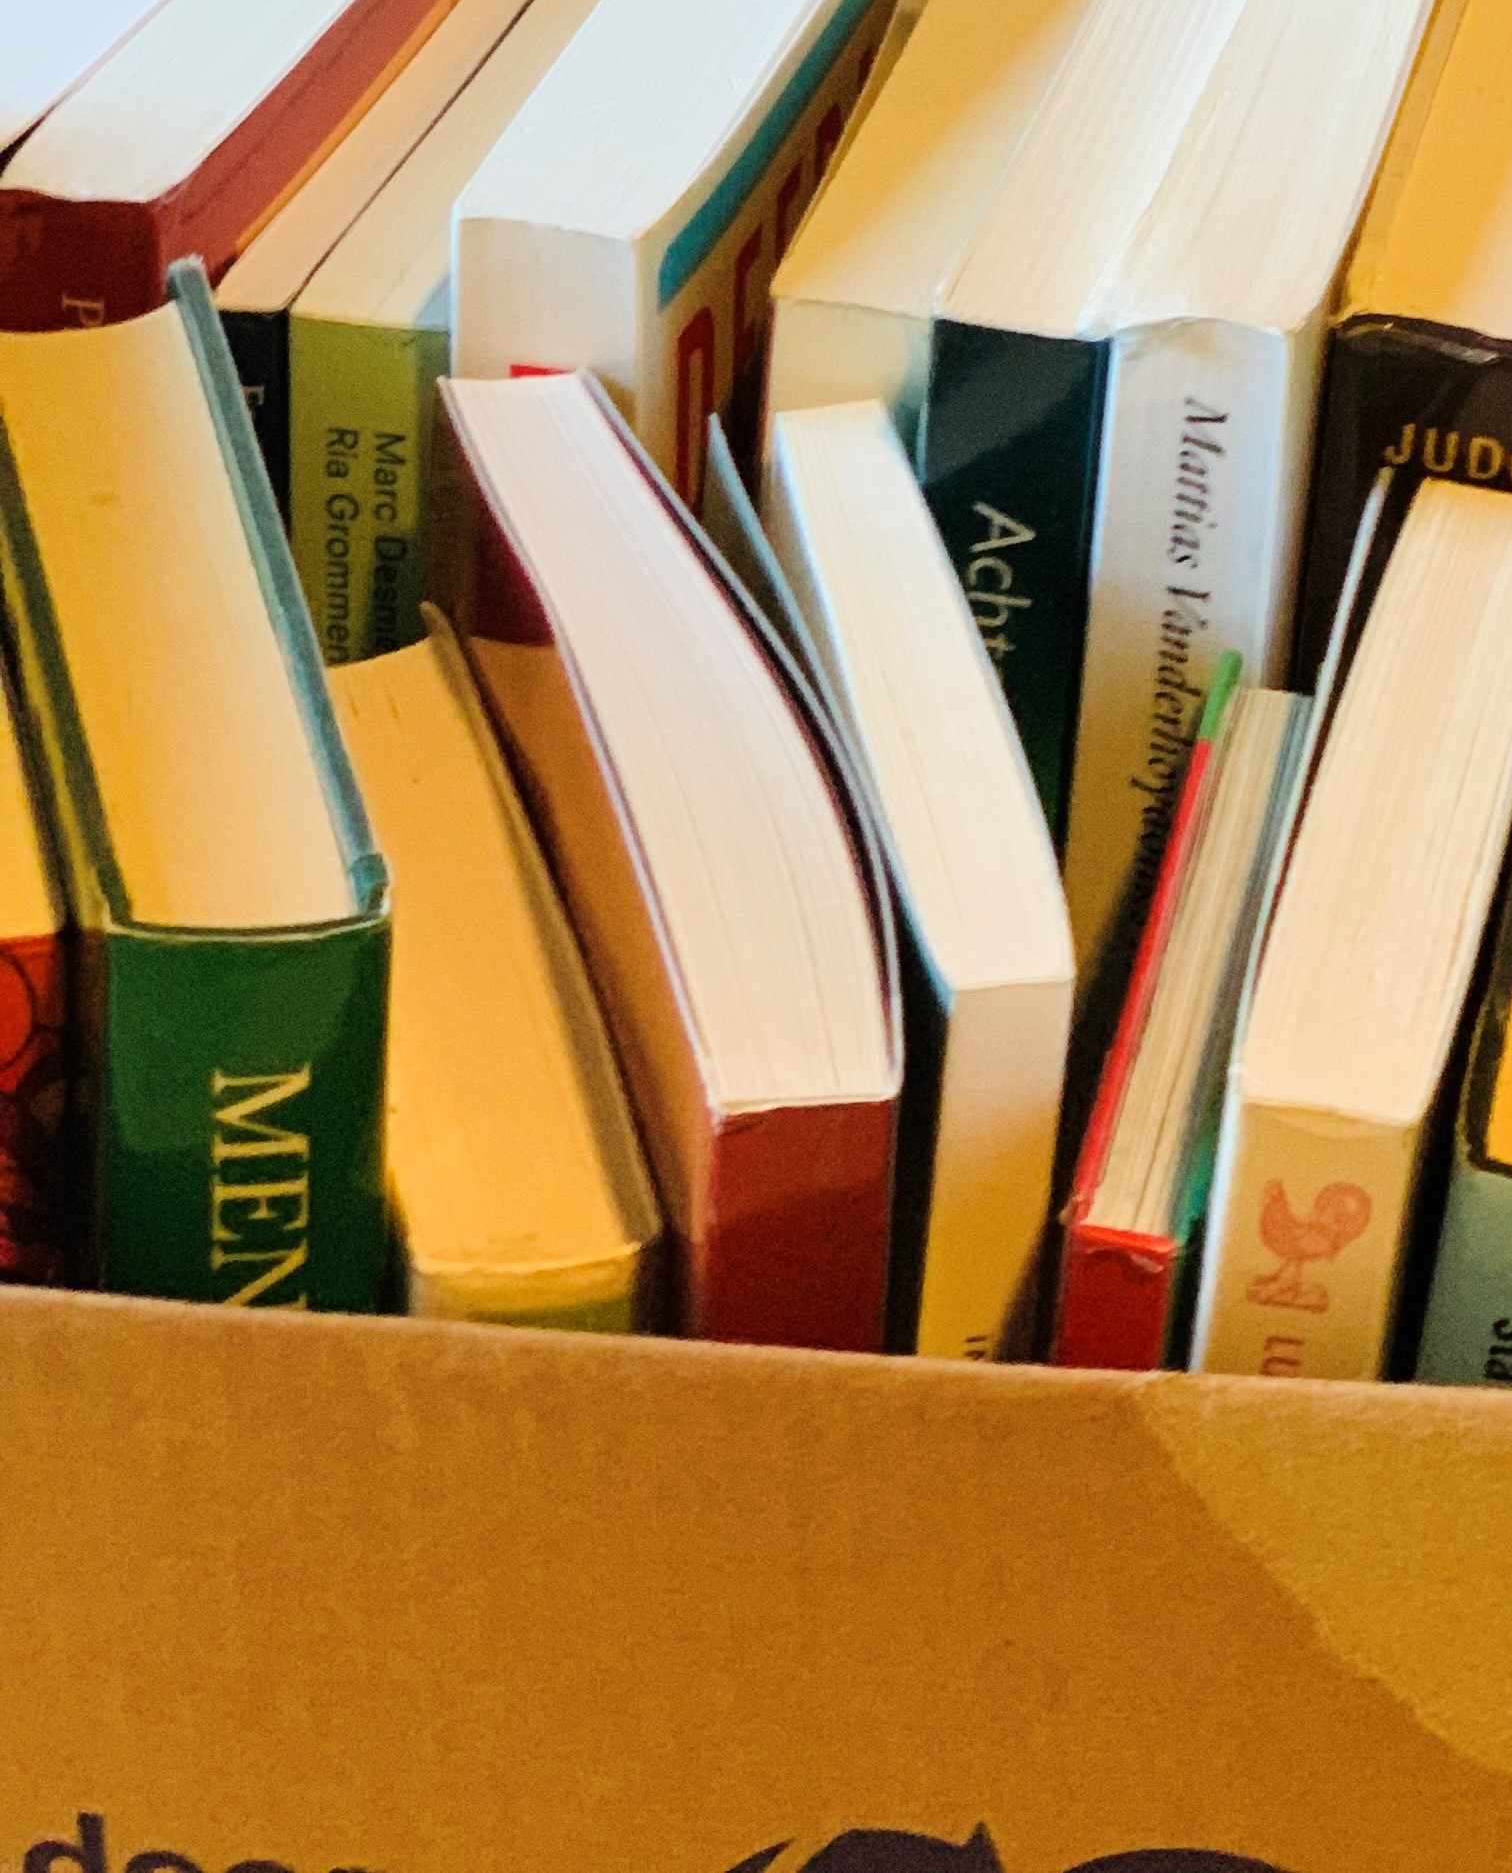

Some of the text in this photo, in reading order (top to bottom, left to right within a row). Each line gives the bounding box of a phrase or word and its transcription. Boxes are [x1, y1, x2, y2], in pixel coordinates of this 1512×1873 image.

[325, 429, 360, 665] Ria Grommen
[373, 433, 405, 522] Marc
[1171, 397, 1230, 570] Mattias
